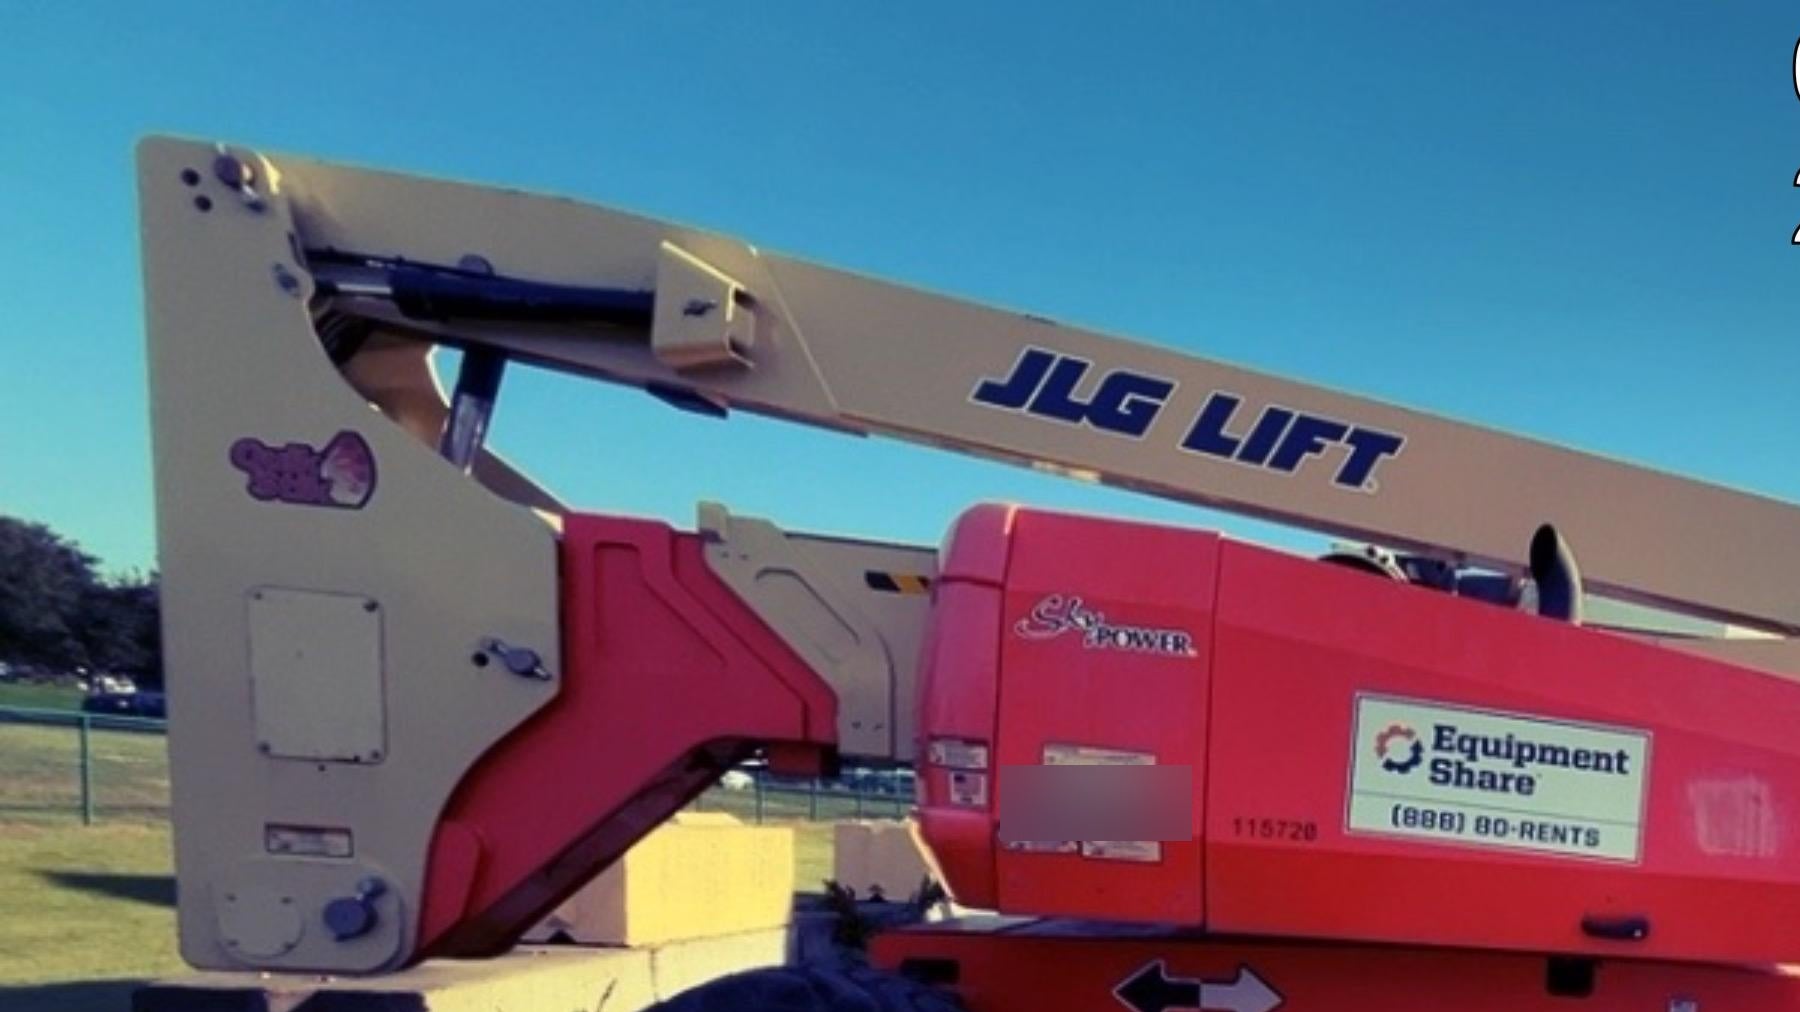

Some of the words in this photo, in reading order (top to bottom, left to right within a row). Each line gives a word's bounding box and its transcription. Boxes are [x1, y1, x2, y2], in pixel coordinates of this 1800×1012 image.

[971, 346, 1178, 440] JLG
[1180, 391, 1404, 488] LIFT
[1097, 626, 1192, 655] POWER
[1431, 724, 1630, 775] Equipment
[1429, 757, 1536, 797] Share
[1232, 817, 1318, 842] 115720
[1391, 803, 1466, 835] (888)
[1474, 815, 1600, 848] 80-RENTS
